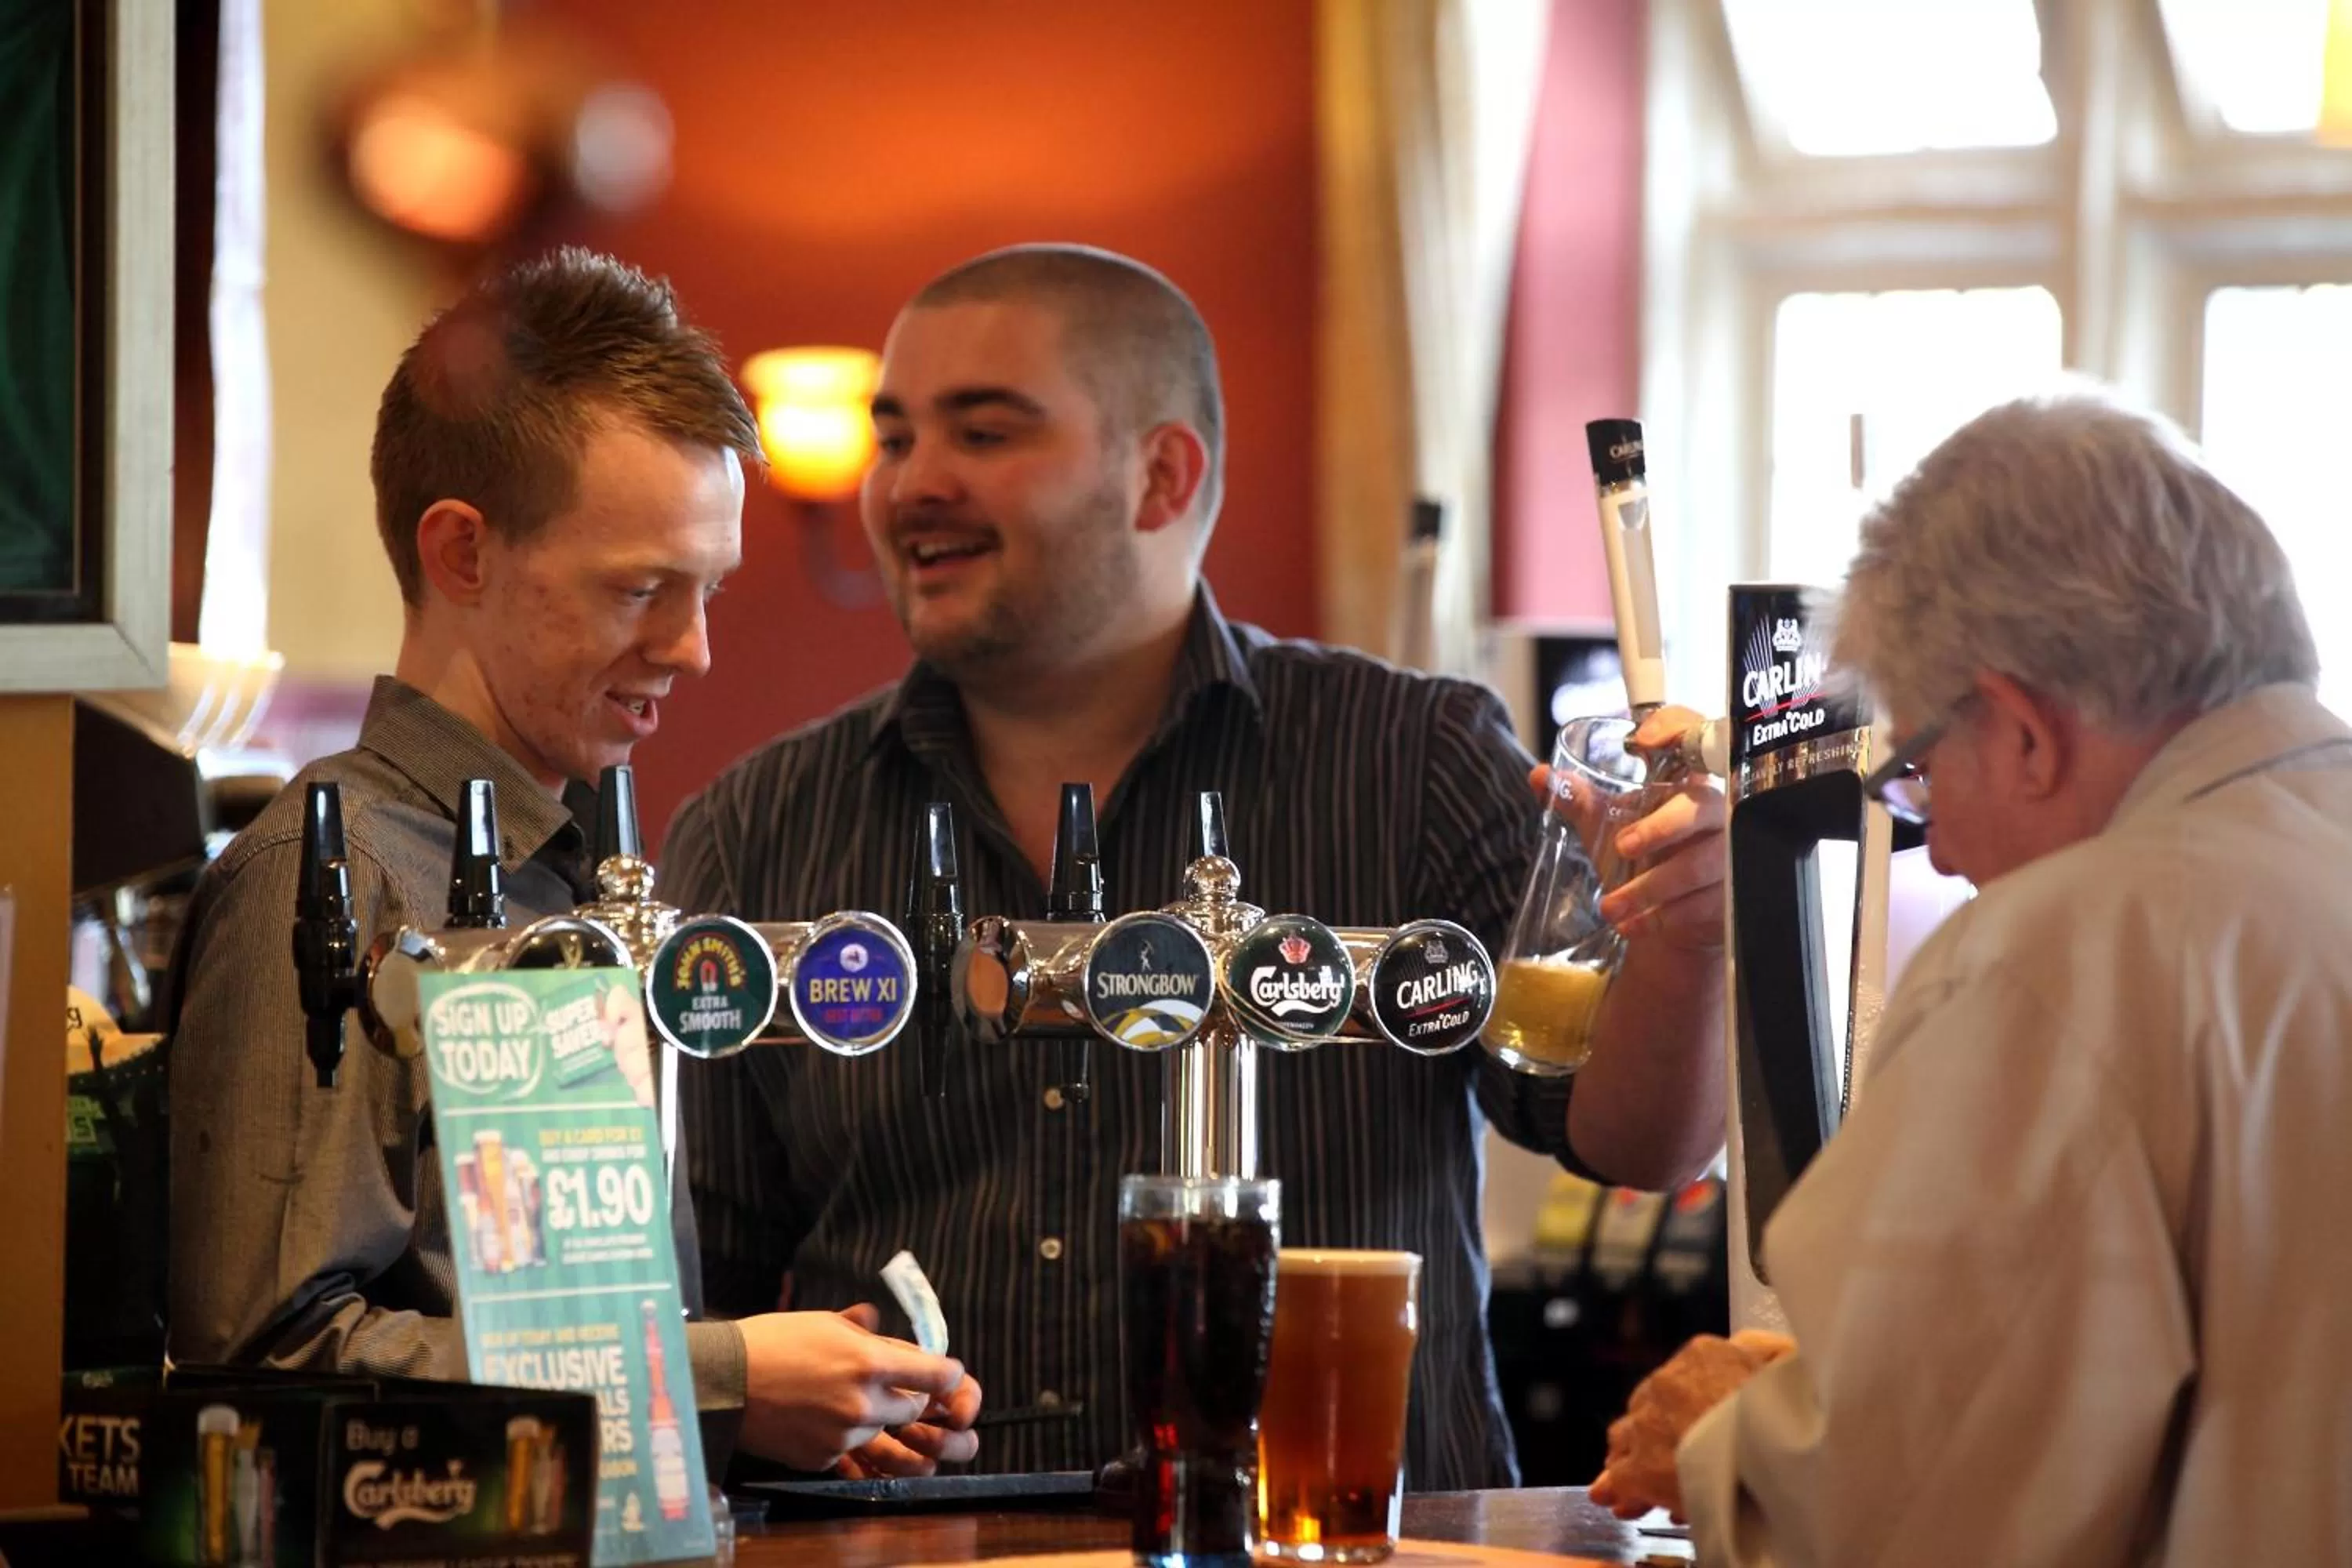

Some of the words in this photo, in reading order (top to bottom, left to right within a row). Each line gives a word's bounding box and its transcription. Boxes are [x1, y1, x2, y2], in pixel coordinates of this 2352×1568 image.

[691, 995, 729, 1011] EXTRA
[809, 978, 872, 1004] BREW
[876, 977, 897, 1002] XI
[1097, 971, 1198, 999] STRONGBOW
[1250, 965, 1344, 1017] Carlsberg
[1396, 959, 1478, 1009] CARLING
[436, 1002, 492, 1037] SIGN
[494, 1001, 529, 1035] UP
[678, 1008, 742, 1034] SMOOTH
[437, 1038, 531, 1082] TODAY
[548, 1164, 653, 1231] £1.90
[481, 1345, 628, 1390] EXCLUSIVE
[346, 1417, 396, 1456] Buy
[401, 1424, 420, 1450] a
[67, 1464, 139, 1497] TEAM
[342, 1457, 477, 1530] Carlsberg
